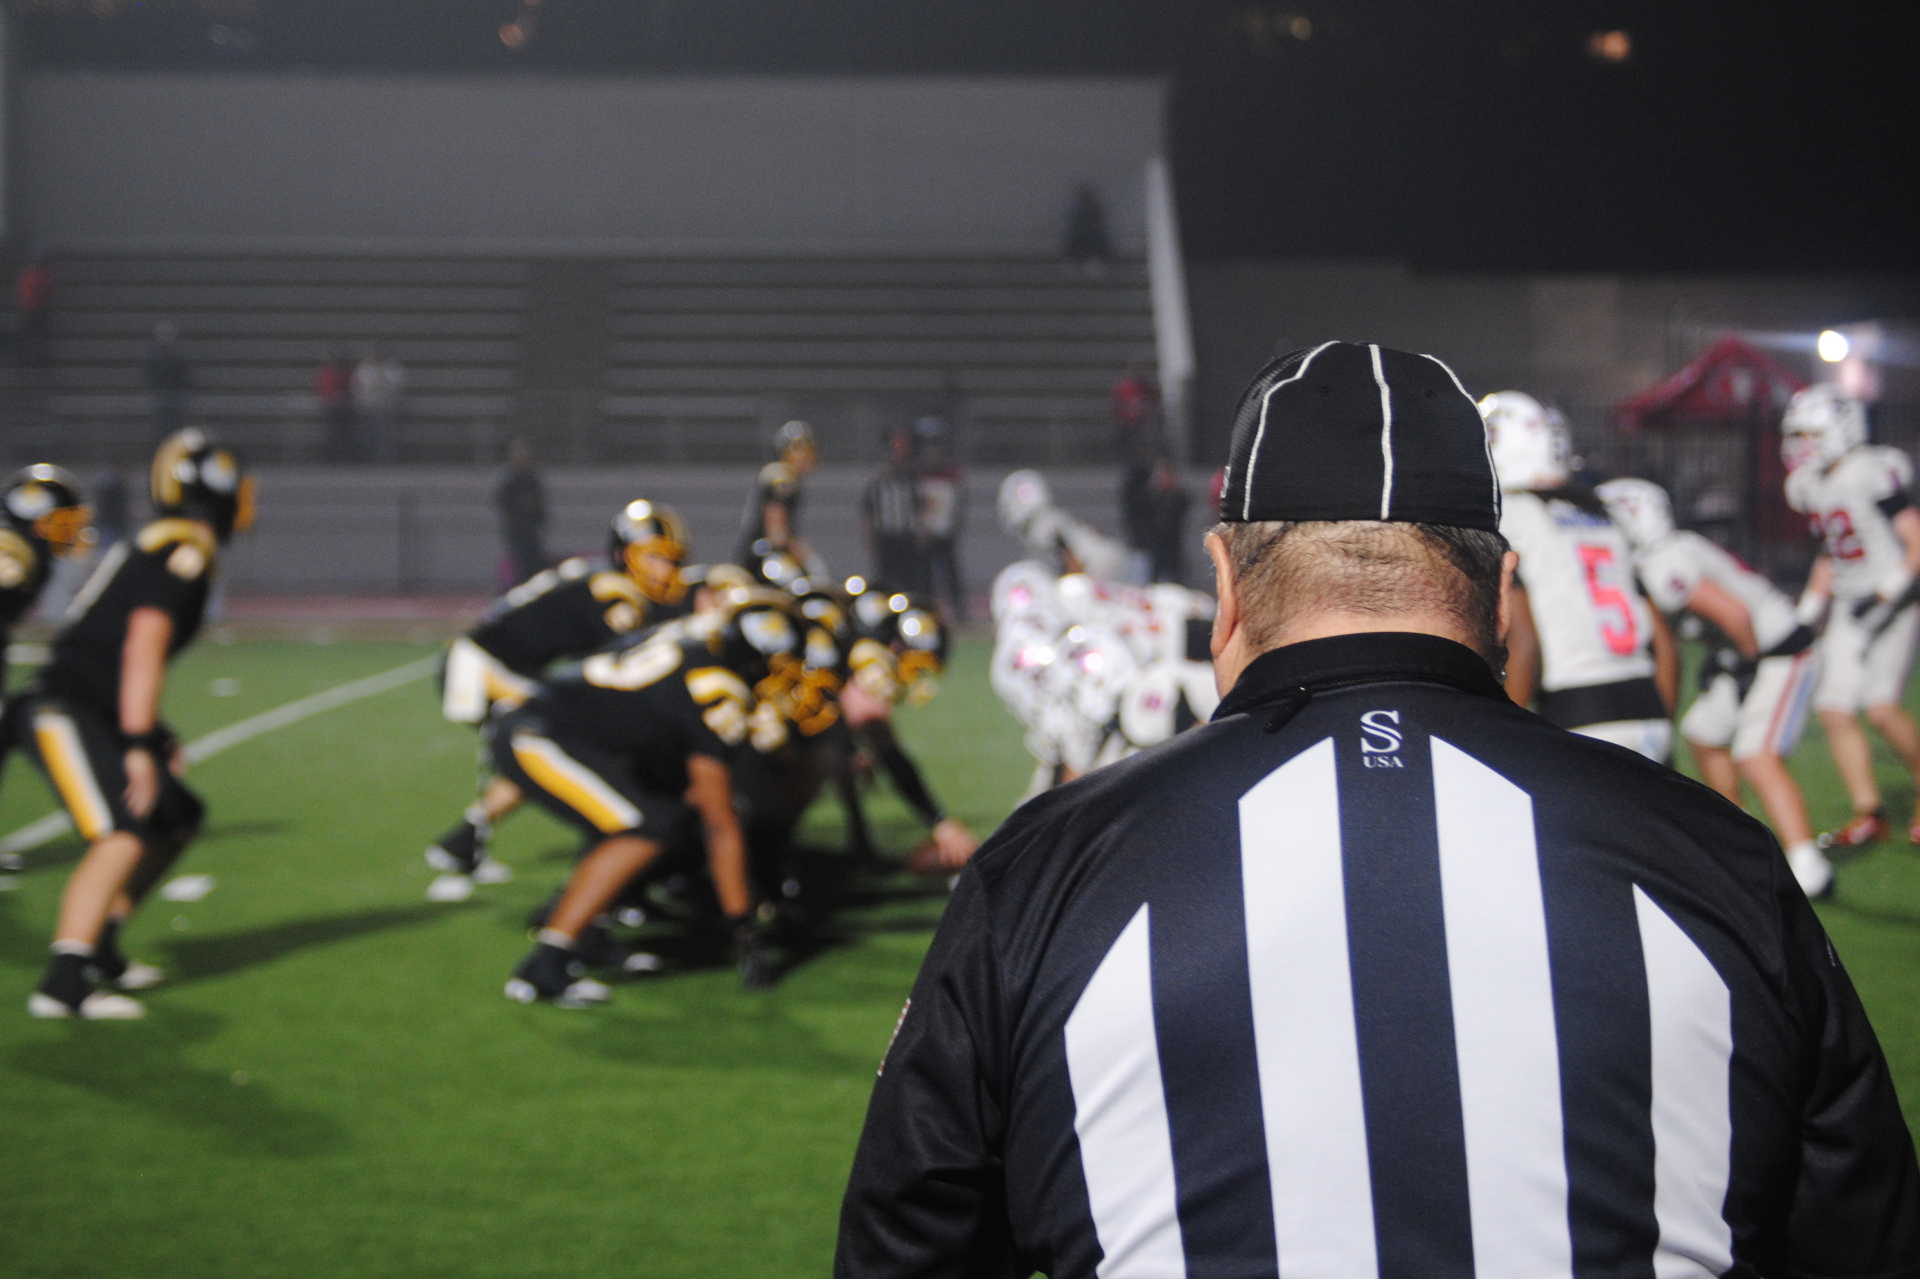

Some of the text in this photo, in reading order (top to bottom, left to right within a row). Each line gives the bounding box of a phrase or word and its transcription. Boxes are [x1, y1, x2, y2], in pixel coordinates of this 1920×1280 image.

[1576, 544, 1639, 658] 5
[1360, 710, 1402, 753] S
[1362, 755, 1404, 769] USA
